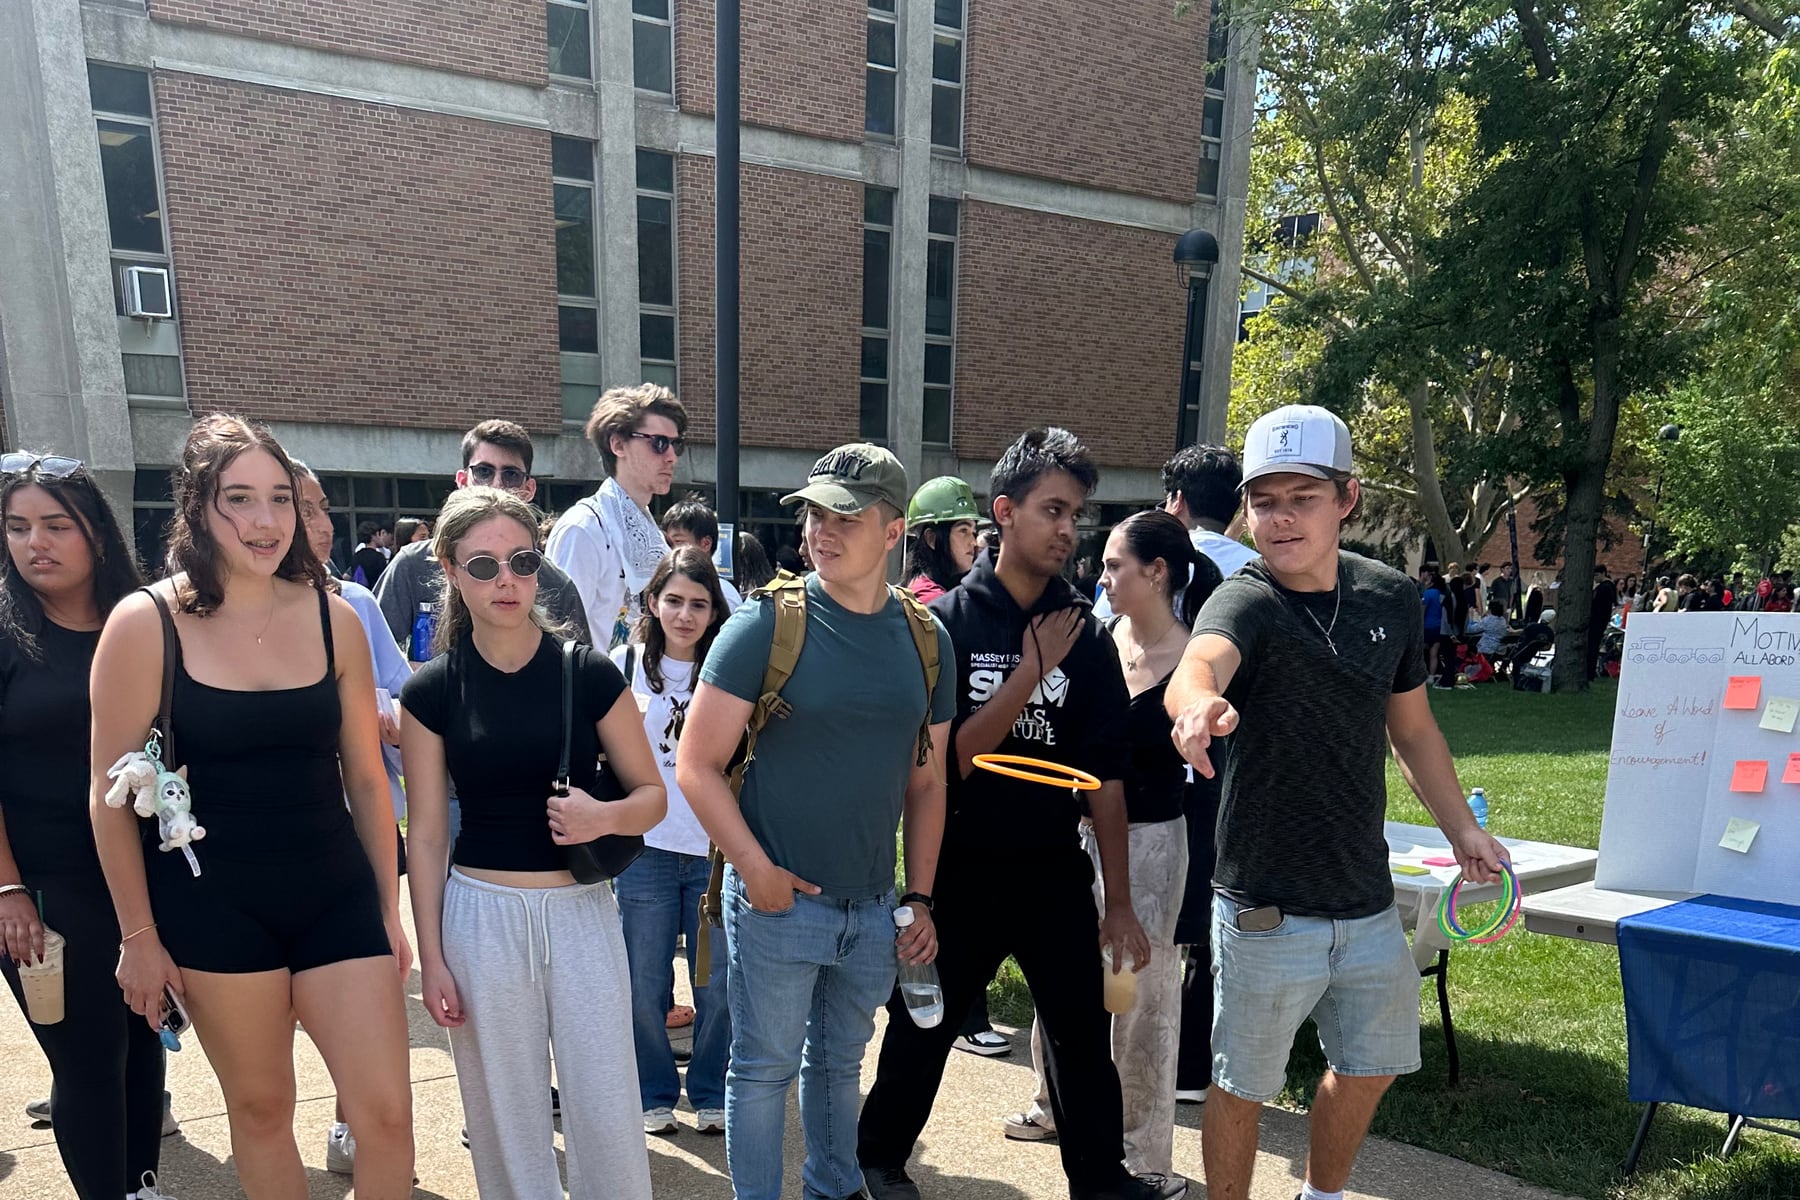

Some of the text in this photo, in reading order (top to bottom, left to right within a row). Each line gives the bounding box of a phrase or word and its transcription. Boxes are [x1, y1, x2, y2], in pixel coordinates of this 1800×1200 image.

[810, 452, 872, 481] ARMY
[1731, 617, 1800, 650] MOTIV
[970, 653, 1005, 663] MASSEY
[1733, 651, 1795, 666] ALL ABORD
